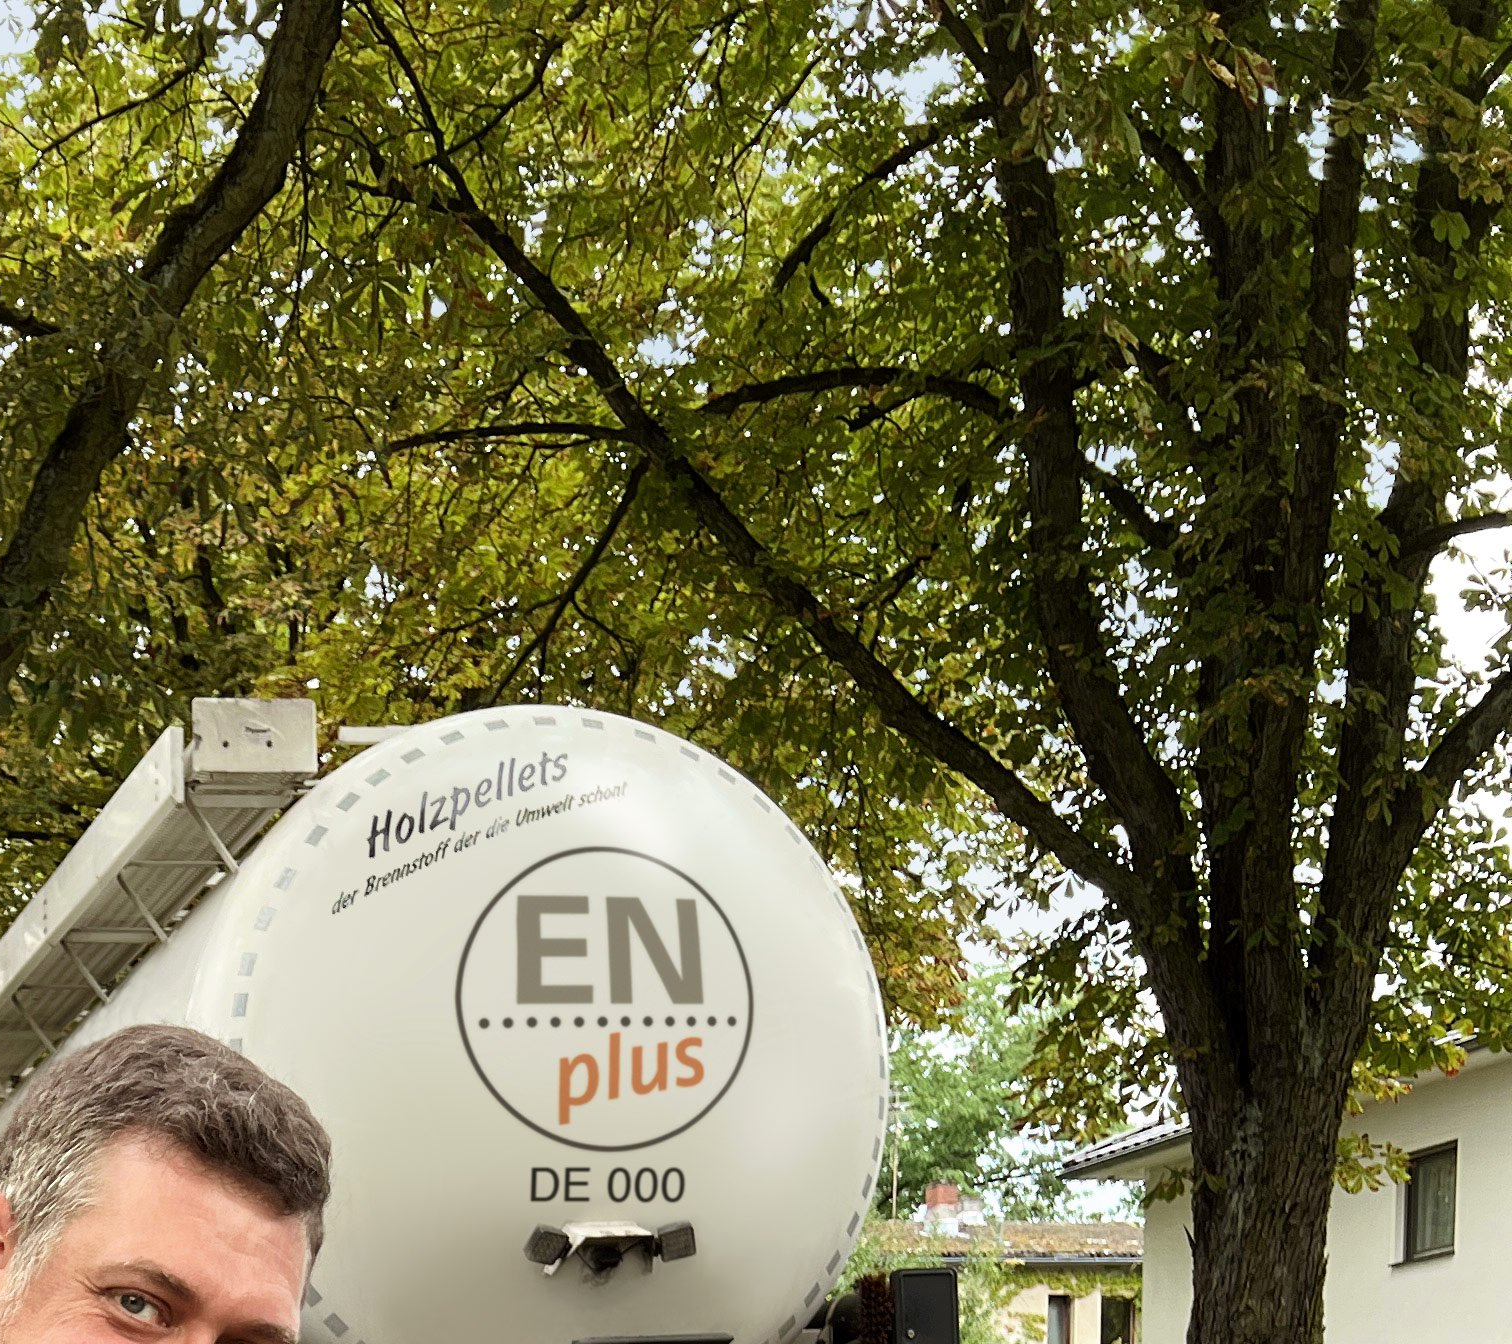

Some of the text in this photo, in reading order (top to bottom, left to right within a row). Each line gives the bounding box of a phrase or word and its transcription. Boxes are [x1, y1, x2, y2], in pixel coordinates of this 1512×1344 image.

[331, 782, 629, 915] der Brennstoff der die Umwelt schont
[367, 752, 568, 858] Holzpellets
[516, 895, 704, 1005] EN
[558, 1032, 705, 1126] plus
[530, 1167, 686, 1203] DE 000
